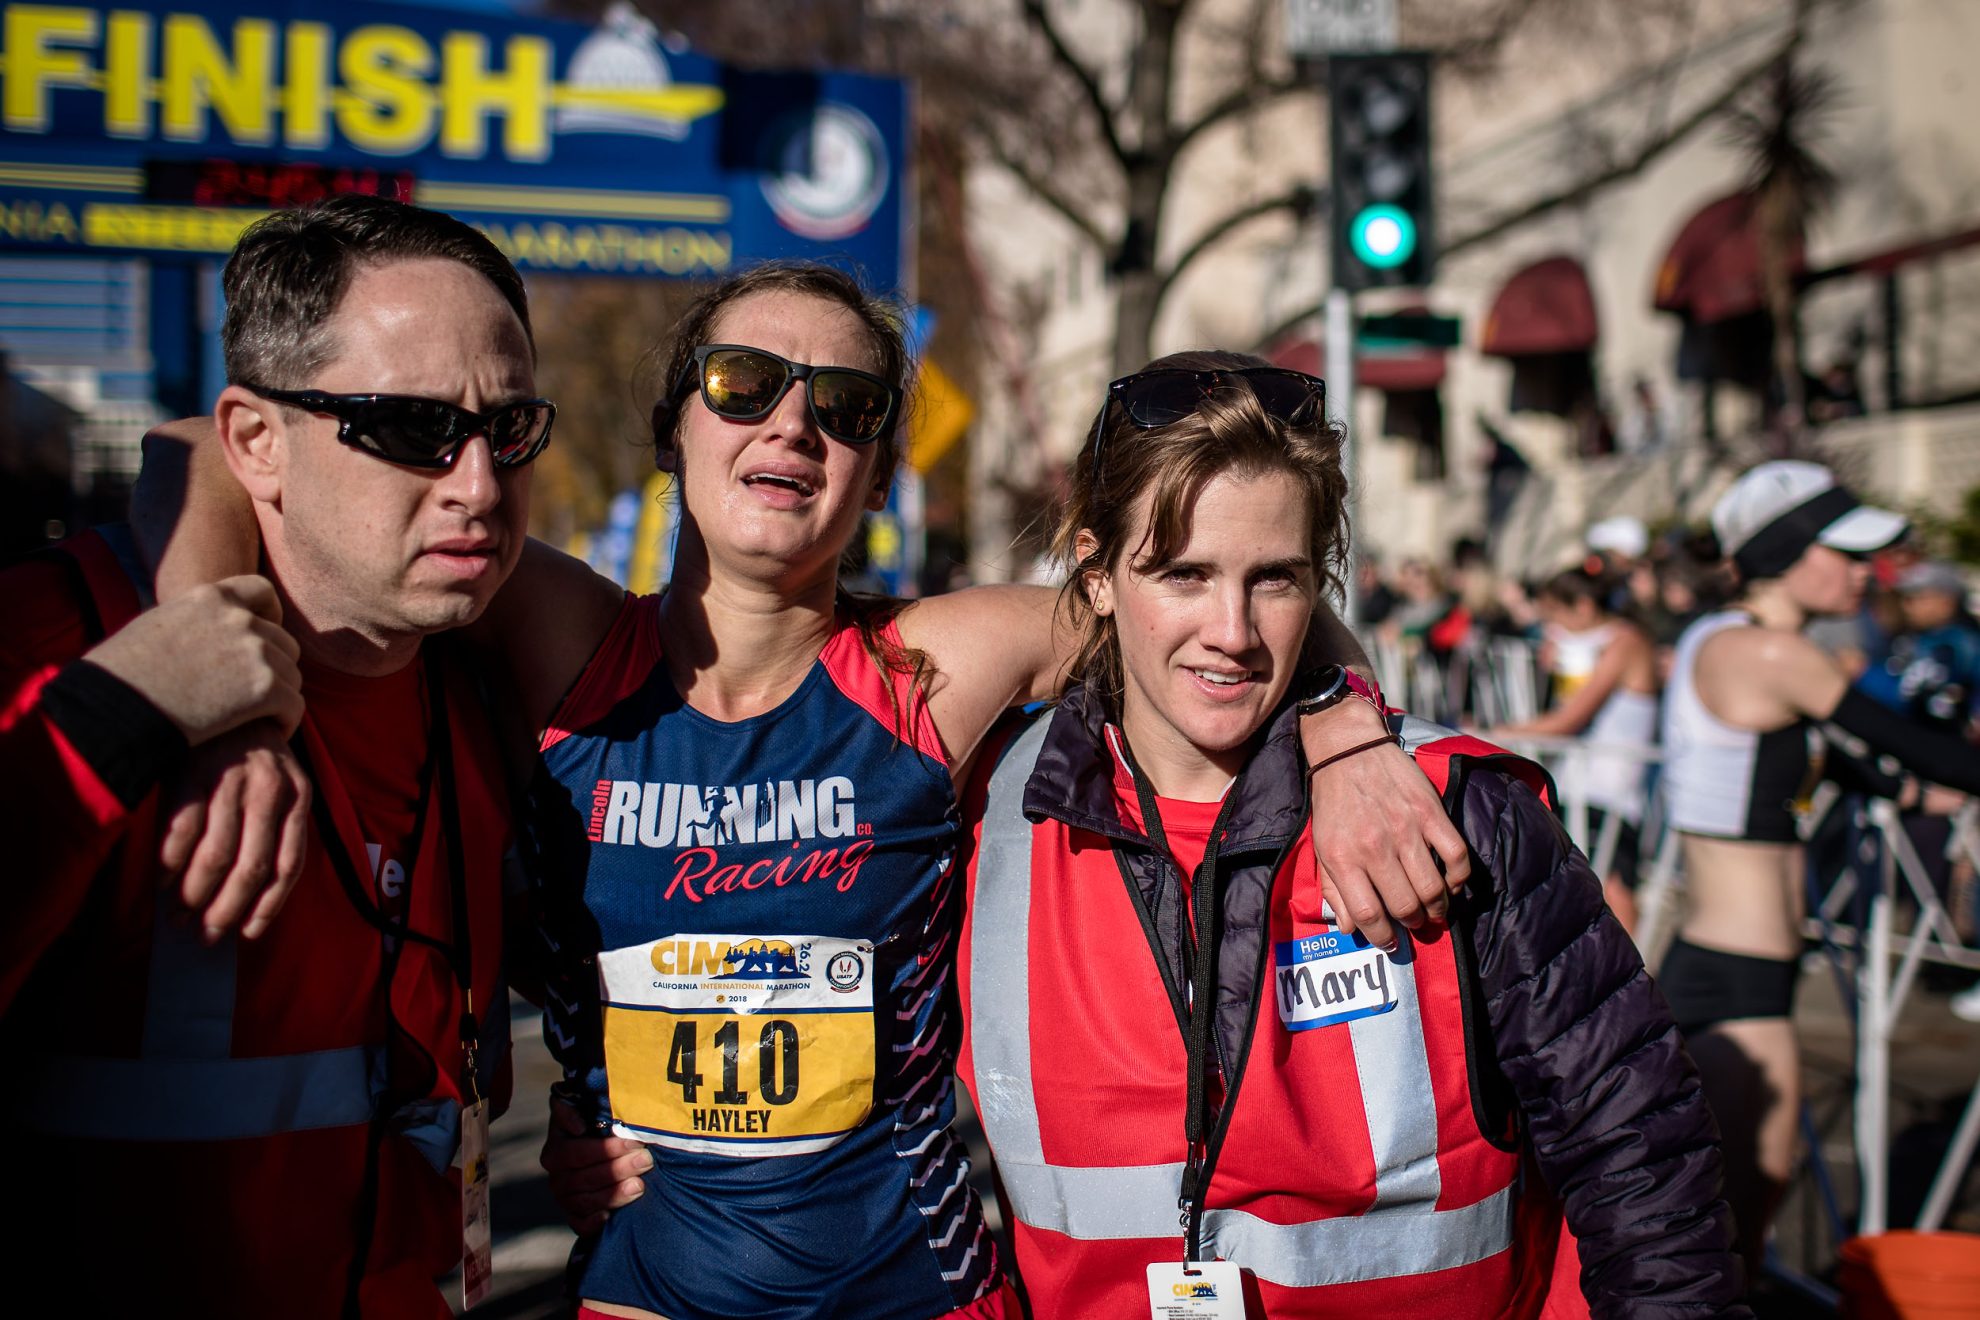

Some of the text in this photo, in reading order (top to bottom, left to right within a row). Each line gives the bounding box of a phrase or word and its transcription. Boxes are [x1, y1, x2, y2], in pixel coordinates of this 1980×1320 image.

[3, 3, 553, 163] FINISH
[587, 779, 612, 842] Lincoln
[603, 776, 874, 848] RUNNING CO.
[664, 840, 875, 902] Racing
[650, 940, 735, 976] CIM
[799, 942, 812, 973] 26.2
[1300, 936, 1338, 954] Hello
[1303, 953, 1313, 961] my
[1314, 949, 1333, 958] name
[653, 981, 811, 991] CALIFORNIA INTERNATIONAL MARATHON
[728, 995, 748, 1003] 2018
[1278, 954, 1390, 1012] Mary
[667, 1020, 800, 1106] 410
[693, 1109, 772, 1133] HAYLEY
